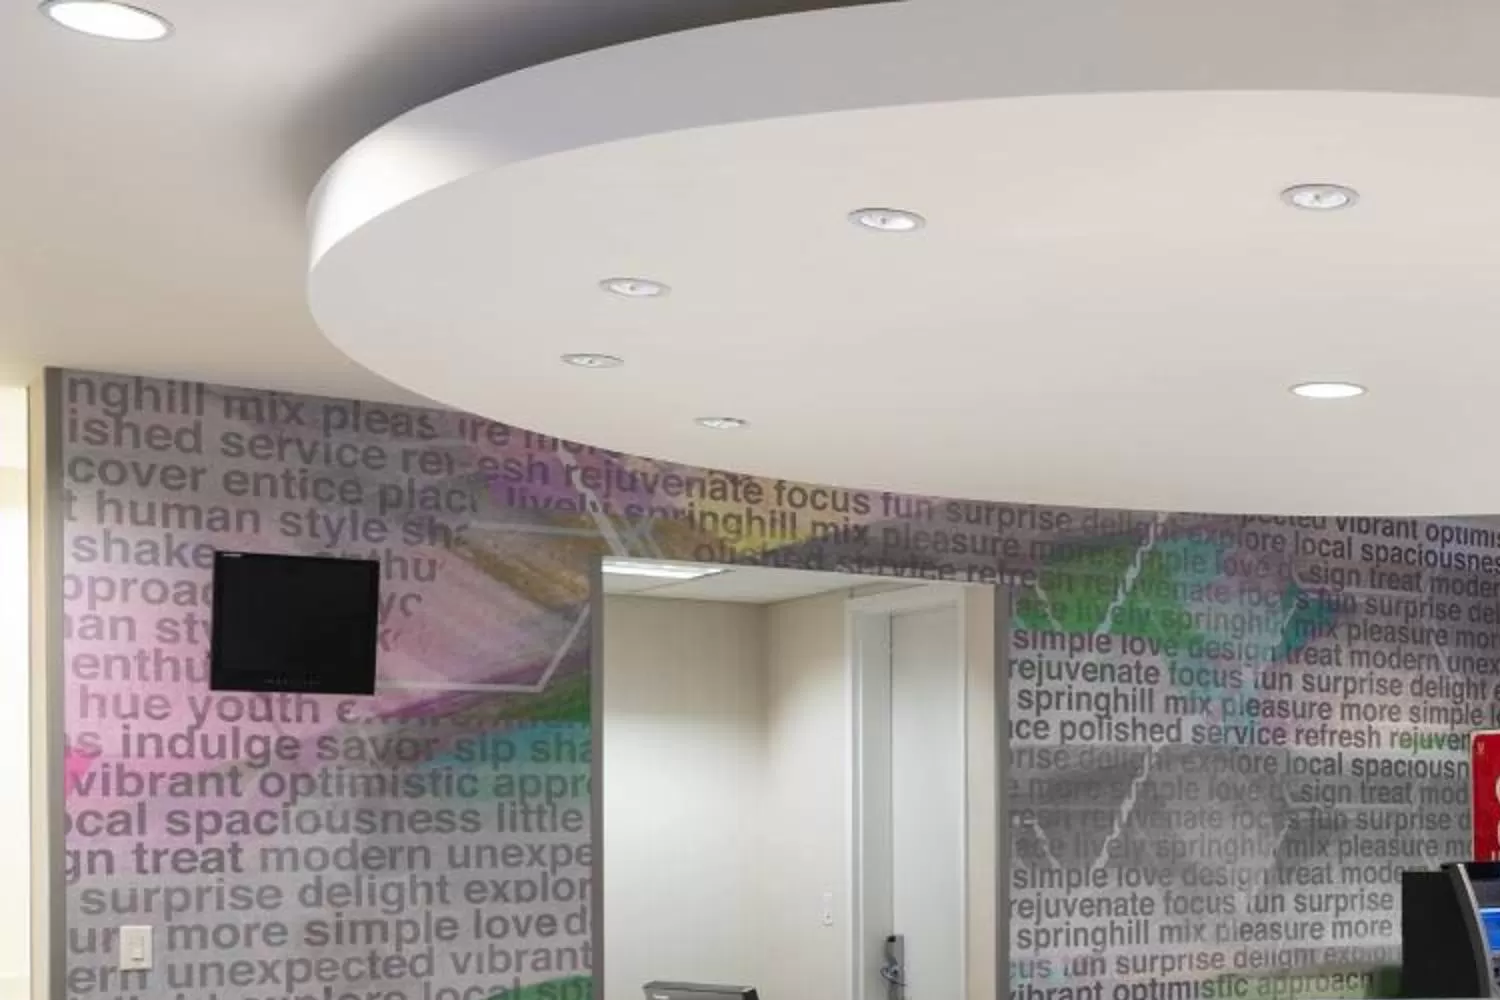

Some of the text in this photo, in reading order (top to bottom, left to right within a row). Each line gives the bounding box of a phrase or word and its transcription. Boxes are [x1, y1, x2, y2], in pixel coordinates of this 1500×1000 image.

[67, 375, 205, 418] nghill
[223, 389, 305, 426] mix
[67, 407, 204, 455] ished
[220, 430, 388, 471] service
[564, 458, 764, 506] rejuvenate
[774, 479, 871, 517] focus
[880, 490, 934, 521] fun
[946, 500, 1073, 534] surprise
[1294, 529, 1353, 560] local
[67, 454, 207, 492] cover
[222, 466, 364, 504] entice
[623, 501, 798, 545] springhill
[811, 516, 871, 546] mix
[882, 521, 1023, 558] pleasure
[1370, 566, 1423, 592] treat
[1336, 515, 1418, 540] vibrant
[71, 528, 214, 570] shake
[96, 488, 260, 534] human
[279, 506, 388, 549] style
[1240, 585, 1310, 612] focs
[1364, 592, 1462, 624] surprise
[1012, 627, 1113, 658] simple
[1121, 633, 1179, 658] love
[1286, 642, 1343, 667] treat
[1349, 646, 1441, 671] modern
[1347, 617, 1449, 646] pleasure
[71, 647, 211, 683] enthu
[1009, 652, 1161, 687] rejuvenate
[1167, 660, 1243, 689] focus
[1302, 669, 1404, 700] surprise
[1409, 675, 1487, 706] delight
[79, 683, 173, 721] hue
[187, 691, 319, 732] youth
[1016, 684, 1154, 719] springhill
[1163, 693, 1214, 715] mix
[1221, 694, 1333, 723] pleasure
[1339, 701, 1401, 723] more
[1408, 701, 1484, 731] simple
[121, 723, 300, 769] indulge
[315, 732, 441, 765] savor
[455, 732, 517, 770] sip
[1059, 715, 1183, 745] polished
[1191, 721, 1287, 747] service
[1295, 723, 1382, 749] refresh
[70, 762, 243, 798] vibrant
[259, 763, 480, 808] optimistic
[1286, 751, 1343, 777] local
[1360, 781, 1412, 804] treat
[165, 801, 482, 845] spaciousness
[497, 799, 584, 834] little
[1231, 807, 1302, 831] focs
[1356, 809, 1451, 837] surprise
[132, 840, 244, 876] treat
[259, 837, 432, 873] modern
[447, 842, 592, 877] unexpe
[1284, 837, 1329, 860] mix
[1338, 835, 1440, 861] pleasure
[79, 877, 283, 923] surprise
[297, 873, 450, 916] delight
[1012, 862, 1109, 895] simple
[1118, 865, 1174, 890] love
[1277, 861, 1335, 886] treat
[1009, 891, 1156, 926] rejuvenate
[1162, 889, 1236, 916] focus
[1293, 887, 1394, 919] surprise
[69, 903, 592, 955] ur more simple love d
[1016, 917, 1394, 953] springhill mix pleasure more
[67, 940, 593, 995] ern unexpected vibrant
[1115, 949, 1225, 977] surprise
[1257, 969, 1375, 999] approach
